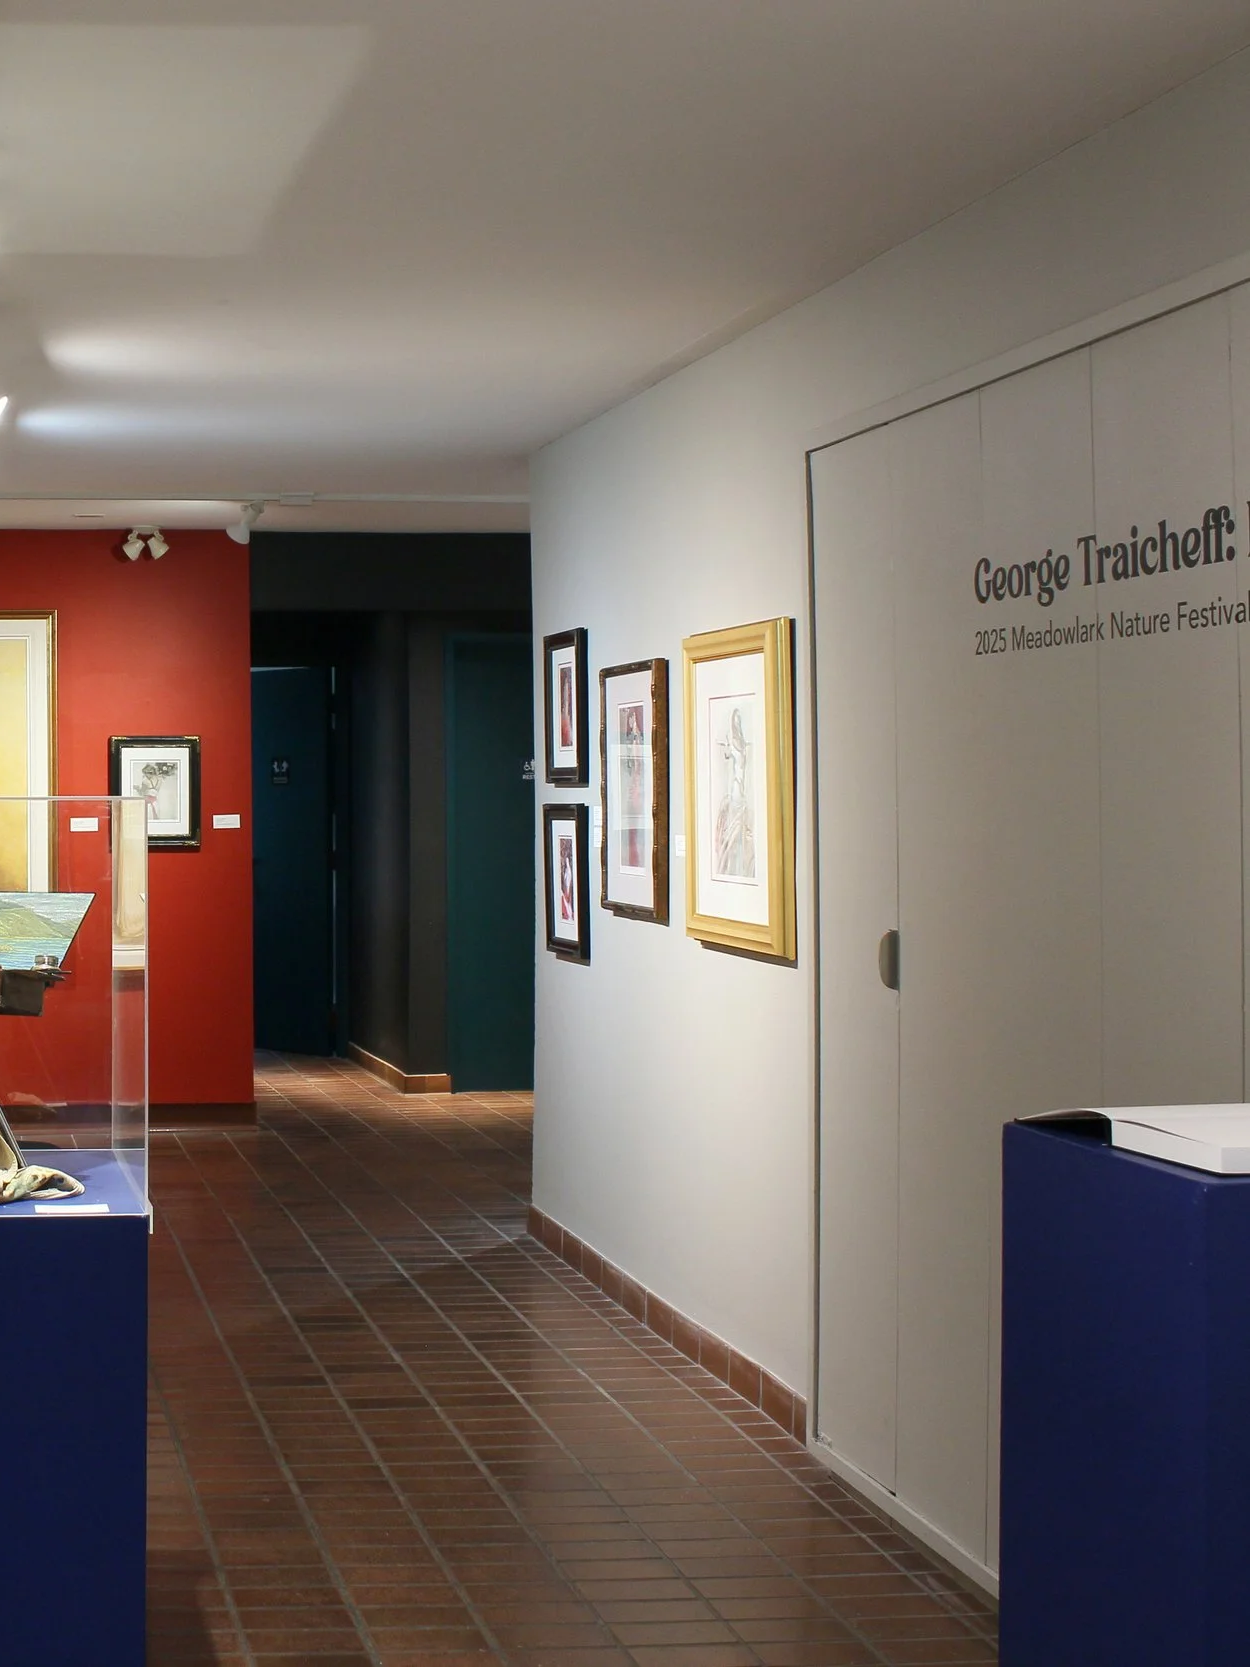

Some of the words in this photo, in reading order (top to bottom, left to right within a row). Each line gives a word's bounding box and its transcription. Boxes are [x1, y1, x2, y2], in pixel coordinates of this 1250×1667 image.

[973, 548, 1071, 608] George
[1076, 504, 1236, 587] Traicheff:
[974, 627, 1007, 656] 2025
[1011, 612, 1105, 652] Meadowlark
[1109, 609, 1171, 640] Nature
